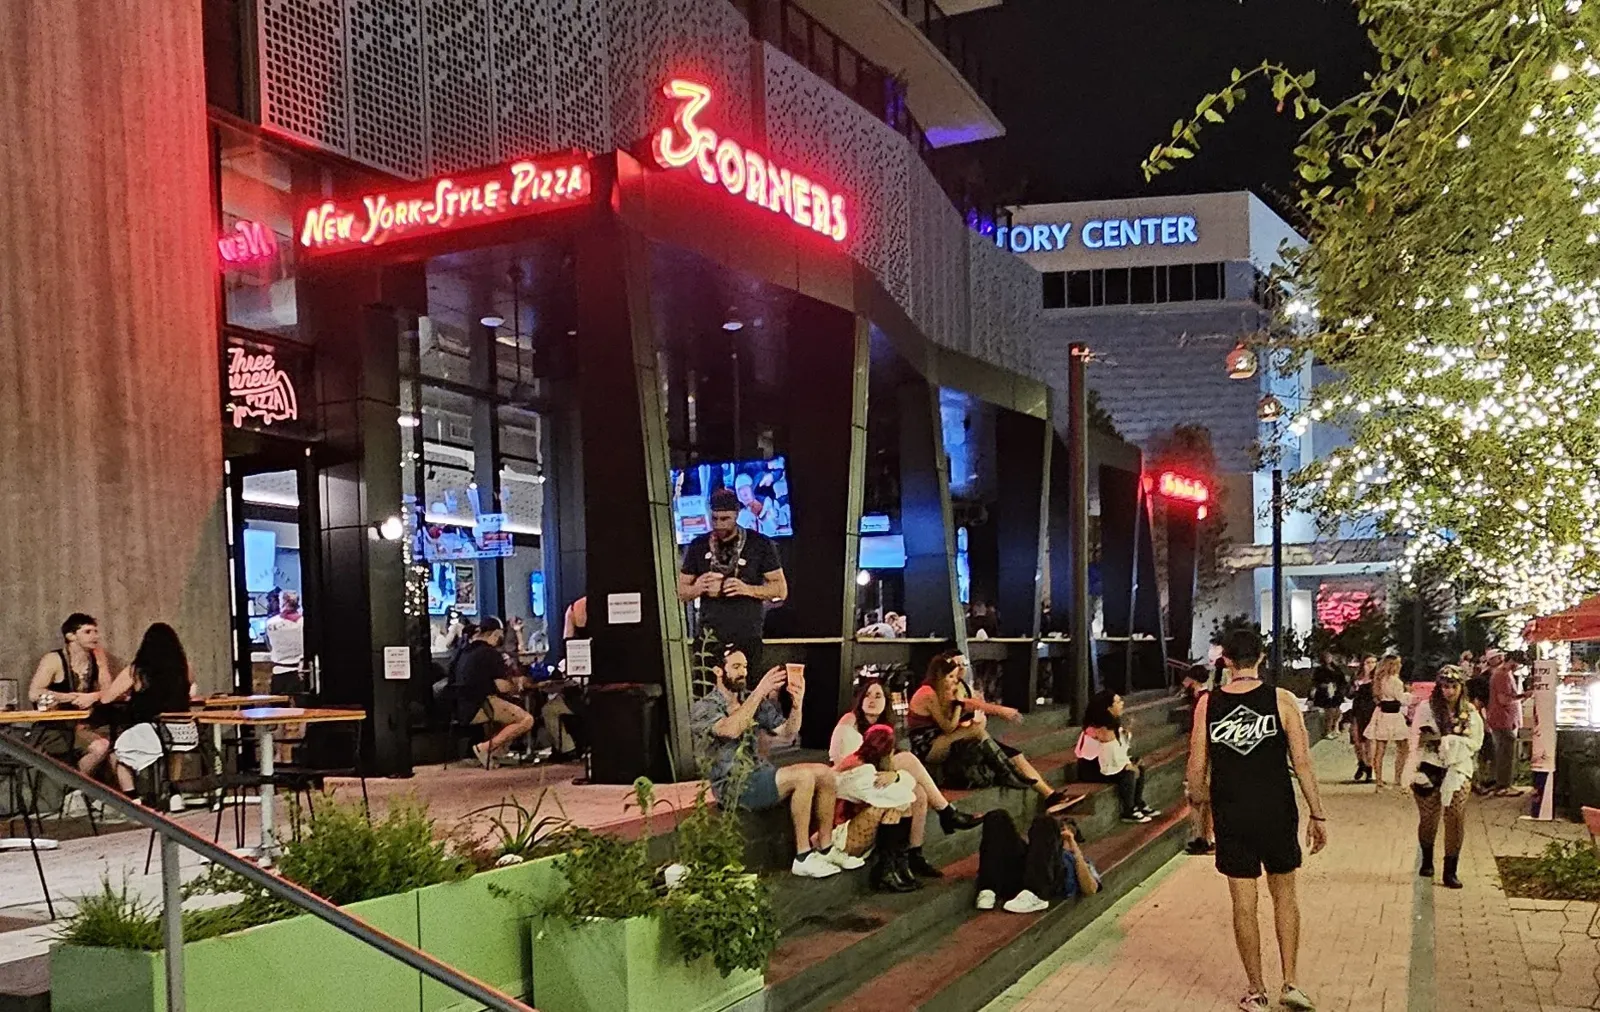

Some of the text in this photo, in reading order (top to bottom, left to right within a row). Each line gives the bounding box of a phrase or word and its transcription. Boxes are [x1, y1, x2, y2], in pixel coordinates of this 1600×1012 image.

[659, 80, 847, 241] 3 CORNERS
[1082, 216, 1198, 248] CENTER
[227, 347, 276, 374] Three
[246, 388, 284, 411] PIZZA
